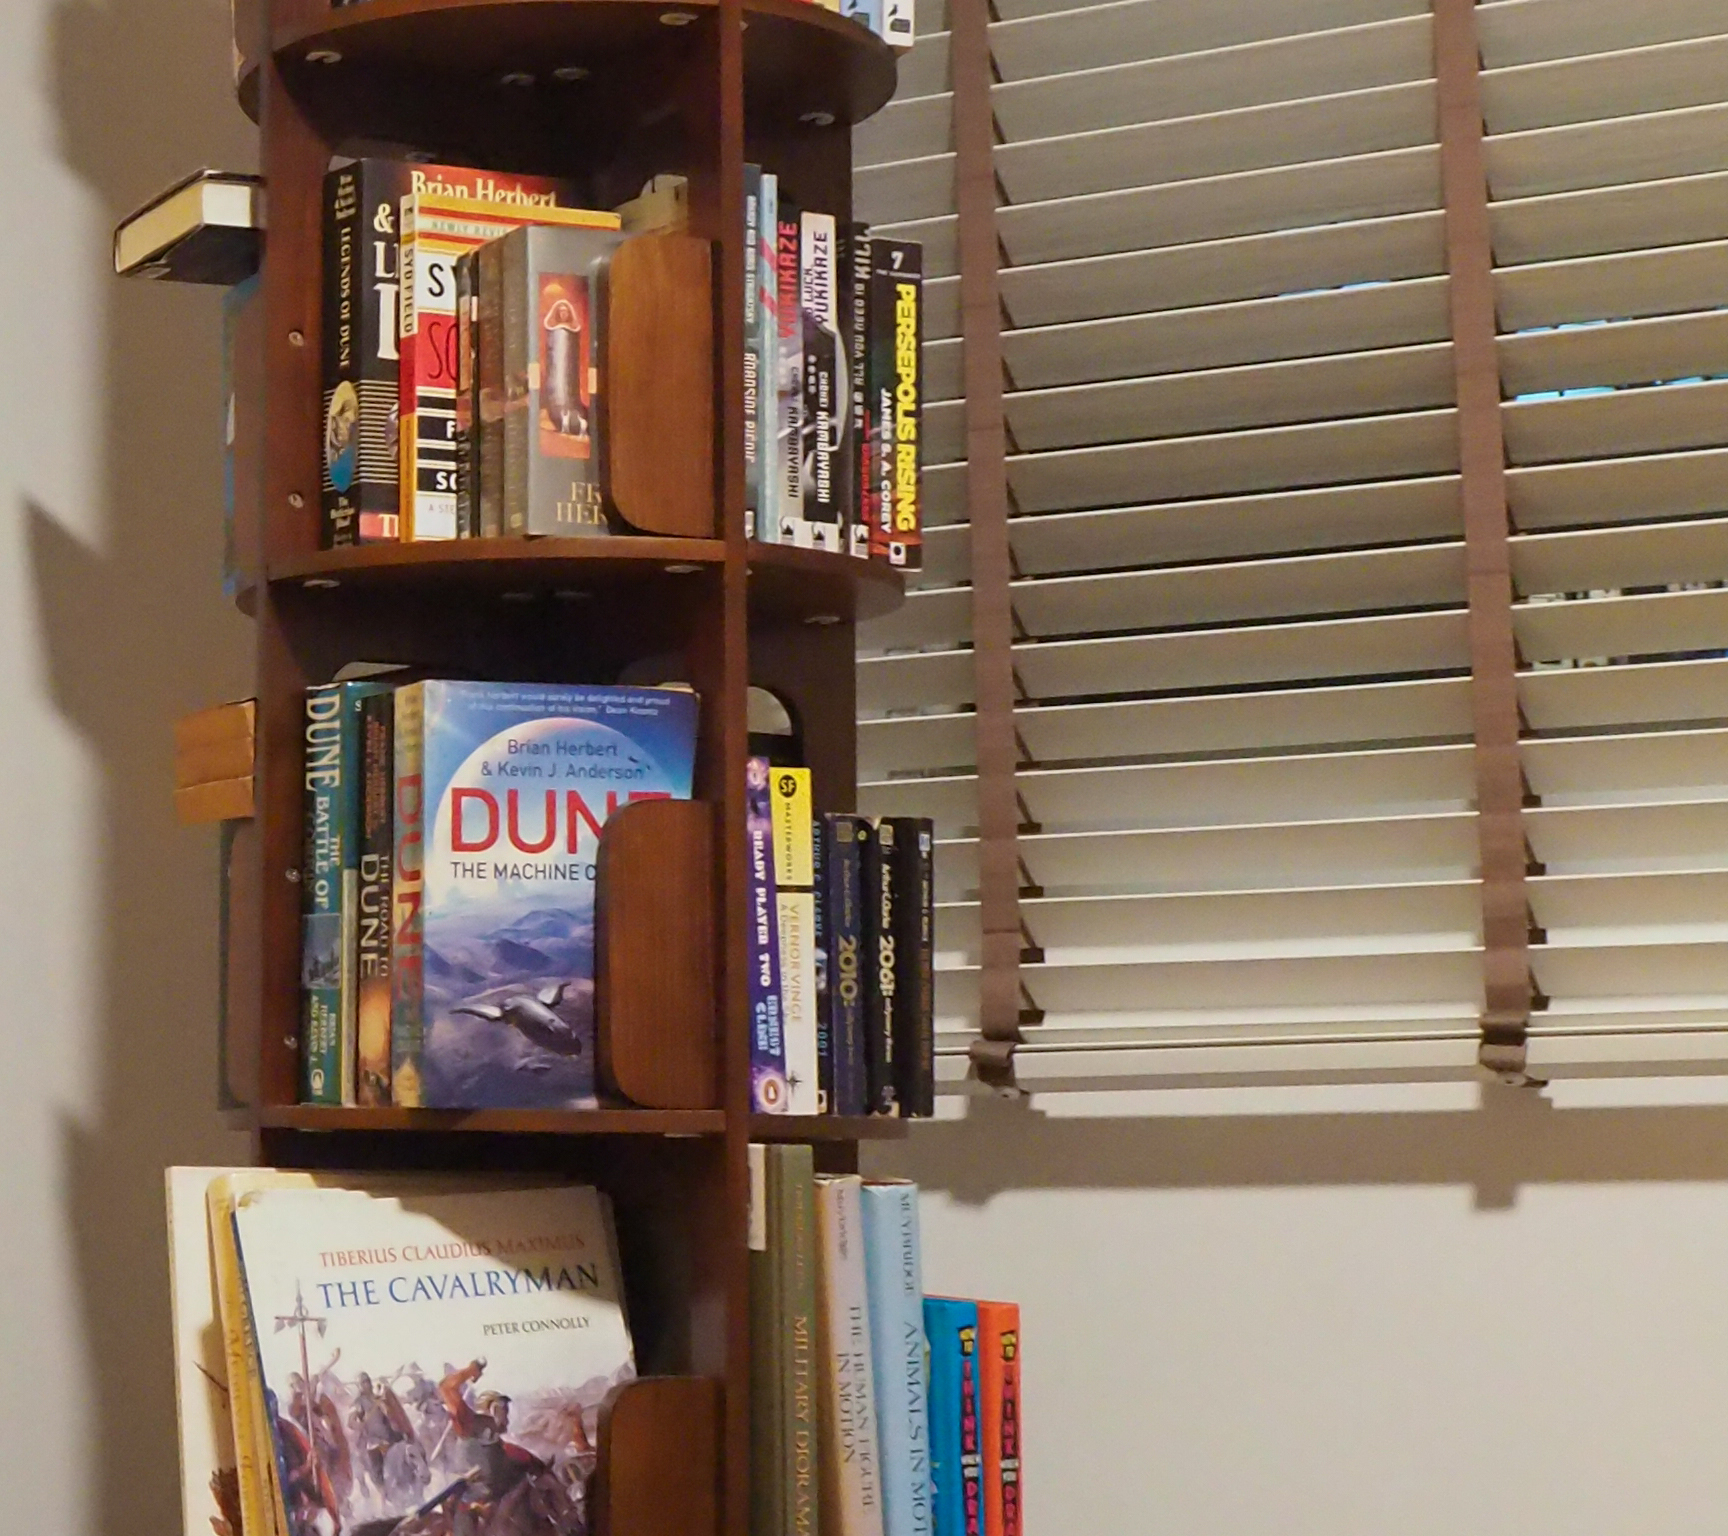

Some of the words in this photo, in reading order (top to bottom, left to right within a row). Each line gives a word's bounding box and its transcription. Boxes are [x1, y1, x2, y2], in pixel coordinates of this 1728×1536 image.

[411, 171, 468, 199] Brian
[476, 178, 556, 208] Herbert
[374, 203, 394, 233] &
[340, 226, 351, 298] LEGENDS
[404, 248, 414, 279] SYD
[814, 230, 829, 324] YUKIKAZE
[854, 228, 872, 279] KILL
[891, 250, 904, 270] 7
[778, 221, 798, 339] YUKIKAZE
[340, 303, 350, 320] OF
[403, 285, 414, 333] FIELD
[854, 300, 865, 331] NEED
[339, 325, 350, 366] DUNE
[854, 336, 866, 359] YOU
[896, 283, 917, 440] PERSEPOLIS
[854, 362, 865, 386] ALL
[881, 387, 892, 438] JAMES
[788, 407, 799, 498] KAMBAYASHI
[881, 440, 892, 457] S.
[881, 460, 891, 476] A.
[881, 479, 892, 534] COREY
[896, 442, 916, 532] RISING
[306, 693, 340, 792] DUNE
[508, 739, 550, 756] Brian
[556, 740, 618, 757] Herbert
[481, 761, 493, 777] &
[497, 762, 543, 778] Kevin
[548, 764, 557, 779] J.
[565, 765, 644, 780] Anderson
[780, 779, 795, 794] SF
[316, 796, 330, 874] BATTLE
[451, 787, 671, 855] DUN
[785, 802, 793, 881] MASTERWORKS
[330, 835, 340, 866] THE
[380, 855, 389, 882] THE
[449, 861, 487, 879] THE
[494, 862, 580, 881] MACHINE
[753, 830, 766, 880] READY
[315, 879, 329, 910] OF
[397, 774, 422, 1001] DUNE
[360, 853, 380, 979] DUNE
[380, 896, 389, 947] ROAD
[756, 887, 769, 944] PLAYER
[789, 904, 800, 971] VERNOR
[380, 956, 389, 977] TO
[759, 953, 771, 987] TWO
[838, 935, 858, 1007] 2010:
[879, 934, 896, 997] 2061:
[790, 975, 802, 1020] VINGE
[818, 1022, 828, 1057] 2001
[319, 1249, 397, 1268] TIBERIUS
[402, 1239, 491, 1262] CLAUDIUS
[497, 1235, 585, 1254] MAXIMUS
[900, 1192, 915, 1293] MUYBRIDGE
[317, 1279, 380, 1309] THE
[388, 1262, 600, 1303] CAVALRYMAN
[483, 1321, 519, 1338] PETER
[522, 1316, 590, 1334] CONNOLLY
[850, 1306, 863, 1347] THE
[793, 1316, 810, 1422] MILITARY
[837, 1353, 850, 1372] IN
[904, 1321, 925, 1442] ANIMALS
[853, 1352, 873, 1436] HUMAN
[838, 1381, 856, 1463] MOTION
[859, 1437, 876, 1512] FIGURE
[911, 1448, 925, 1473] IN
